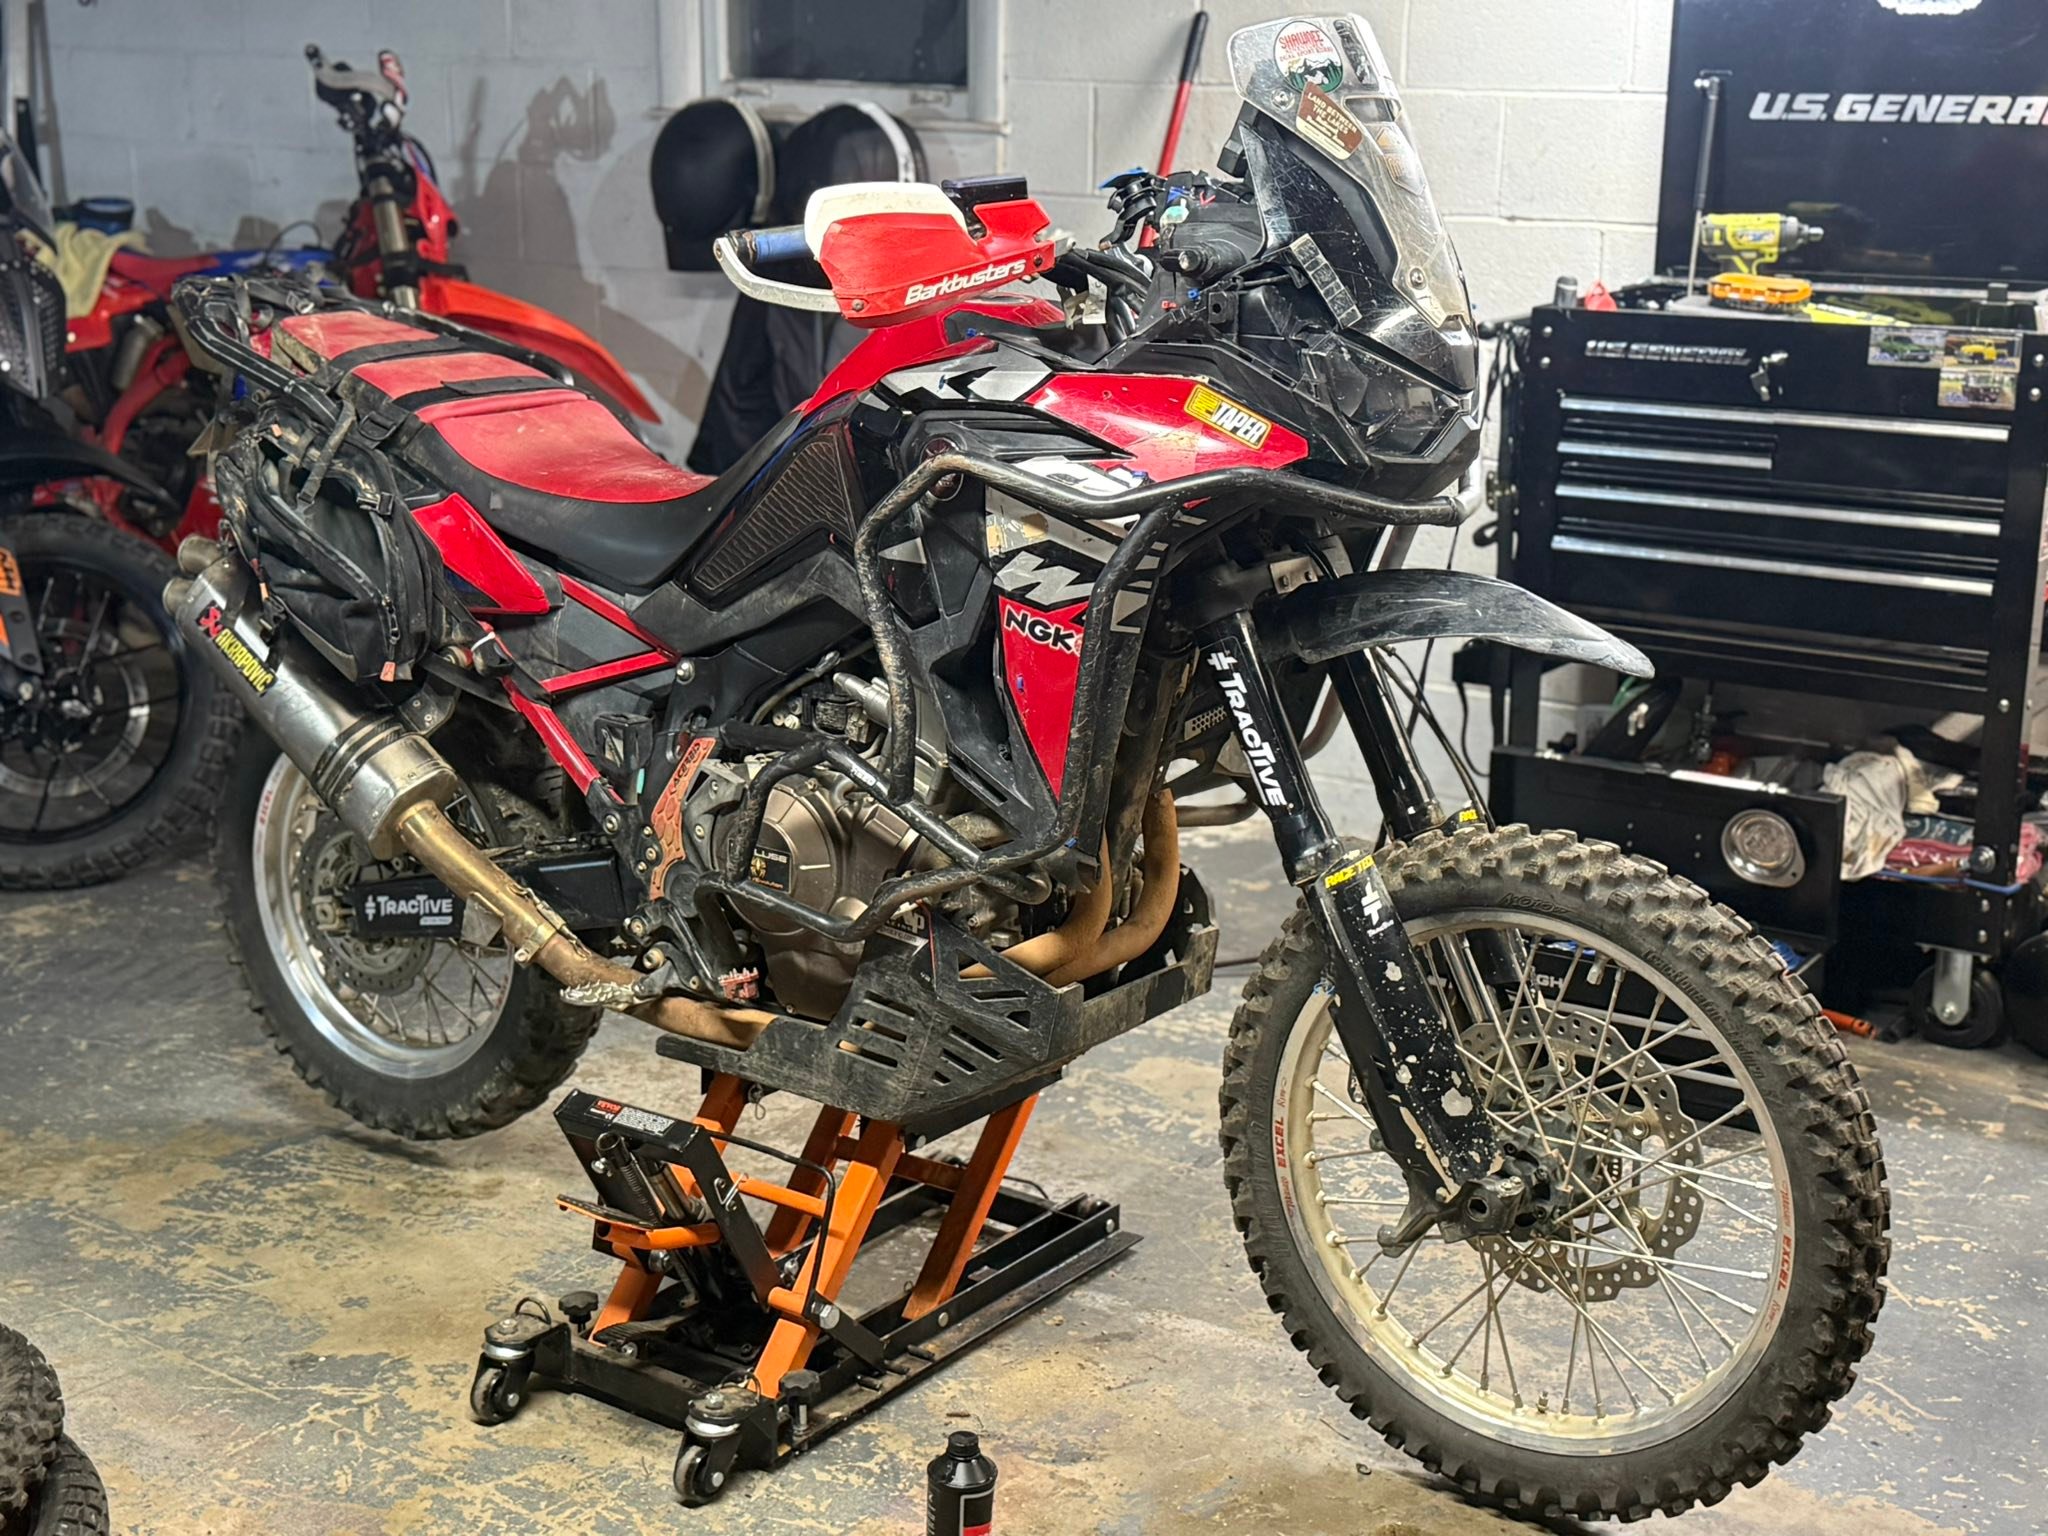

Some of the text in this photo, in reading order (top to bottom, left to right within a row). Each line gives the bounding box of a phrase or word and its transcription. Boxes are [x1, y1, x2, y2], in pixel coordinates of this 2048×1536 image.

[1749, 92, 2048, 125] U.S. GENERA
[904, 258, 1026, 306] Barkbusters
[1211, 401, 1269, 444] TAPER
[1004, 608, 1075, 653] NGK
[1274, 1116, 1287, 1169] EXCEL
[1778, 1235, 1792, 1291] EXCEL
